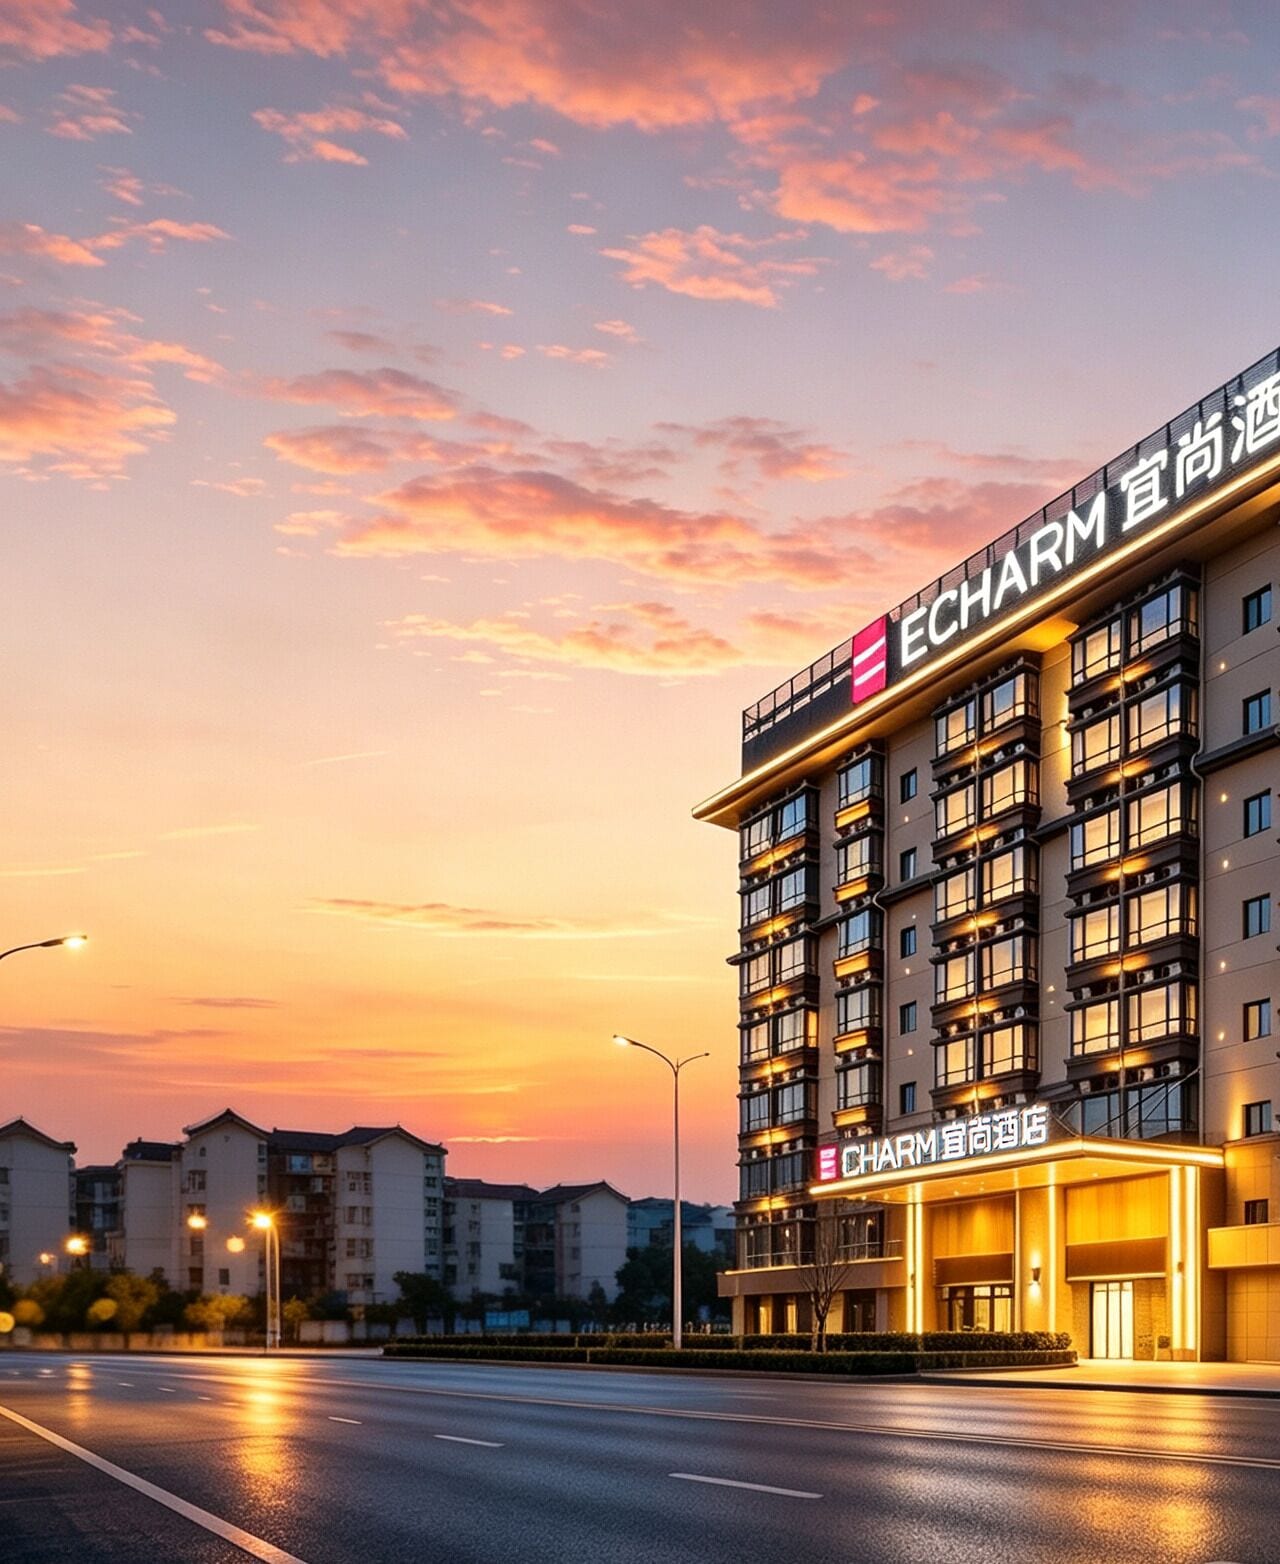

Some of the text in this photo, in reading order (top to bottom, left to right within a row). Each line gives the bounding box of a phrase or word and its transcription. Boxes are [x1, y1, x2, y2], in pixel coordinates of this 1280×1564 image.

[900, 490, 1107, 667] ECHARM
[941, 1104, 1049, 1160] 宜尚酒店
